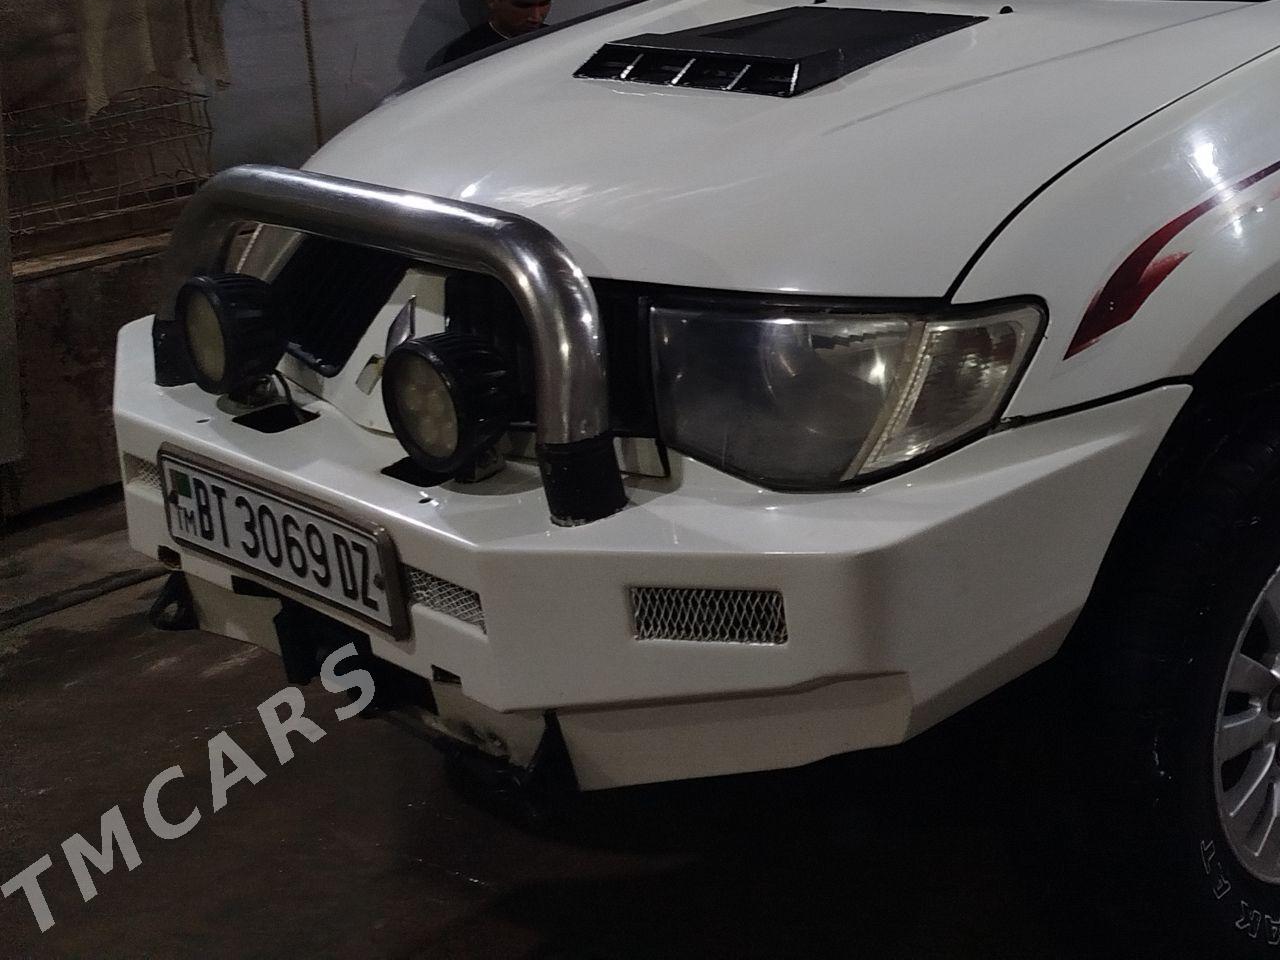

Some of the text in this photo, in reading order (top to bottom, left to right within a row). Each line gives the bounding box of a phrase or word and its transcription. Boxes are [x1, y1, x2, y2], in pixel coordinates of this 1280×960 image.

[176, 504, 197, 536] TM
[194, 479, 379, 612] BT 3069 DZ
